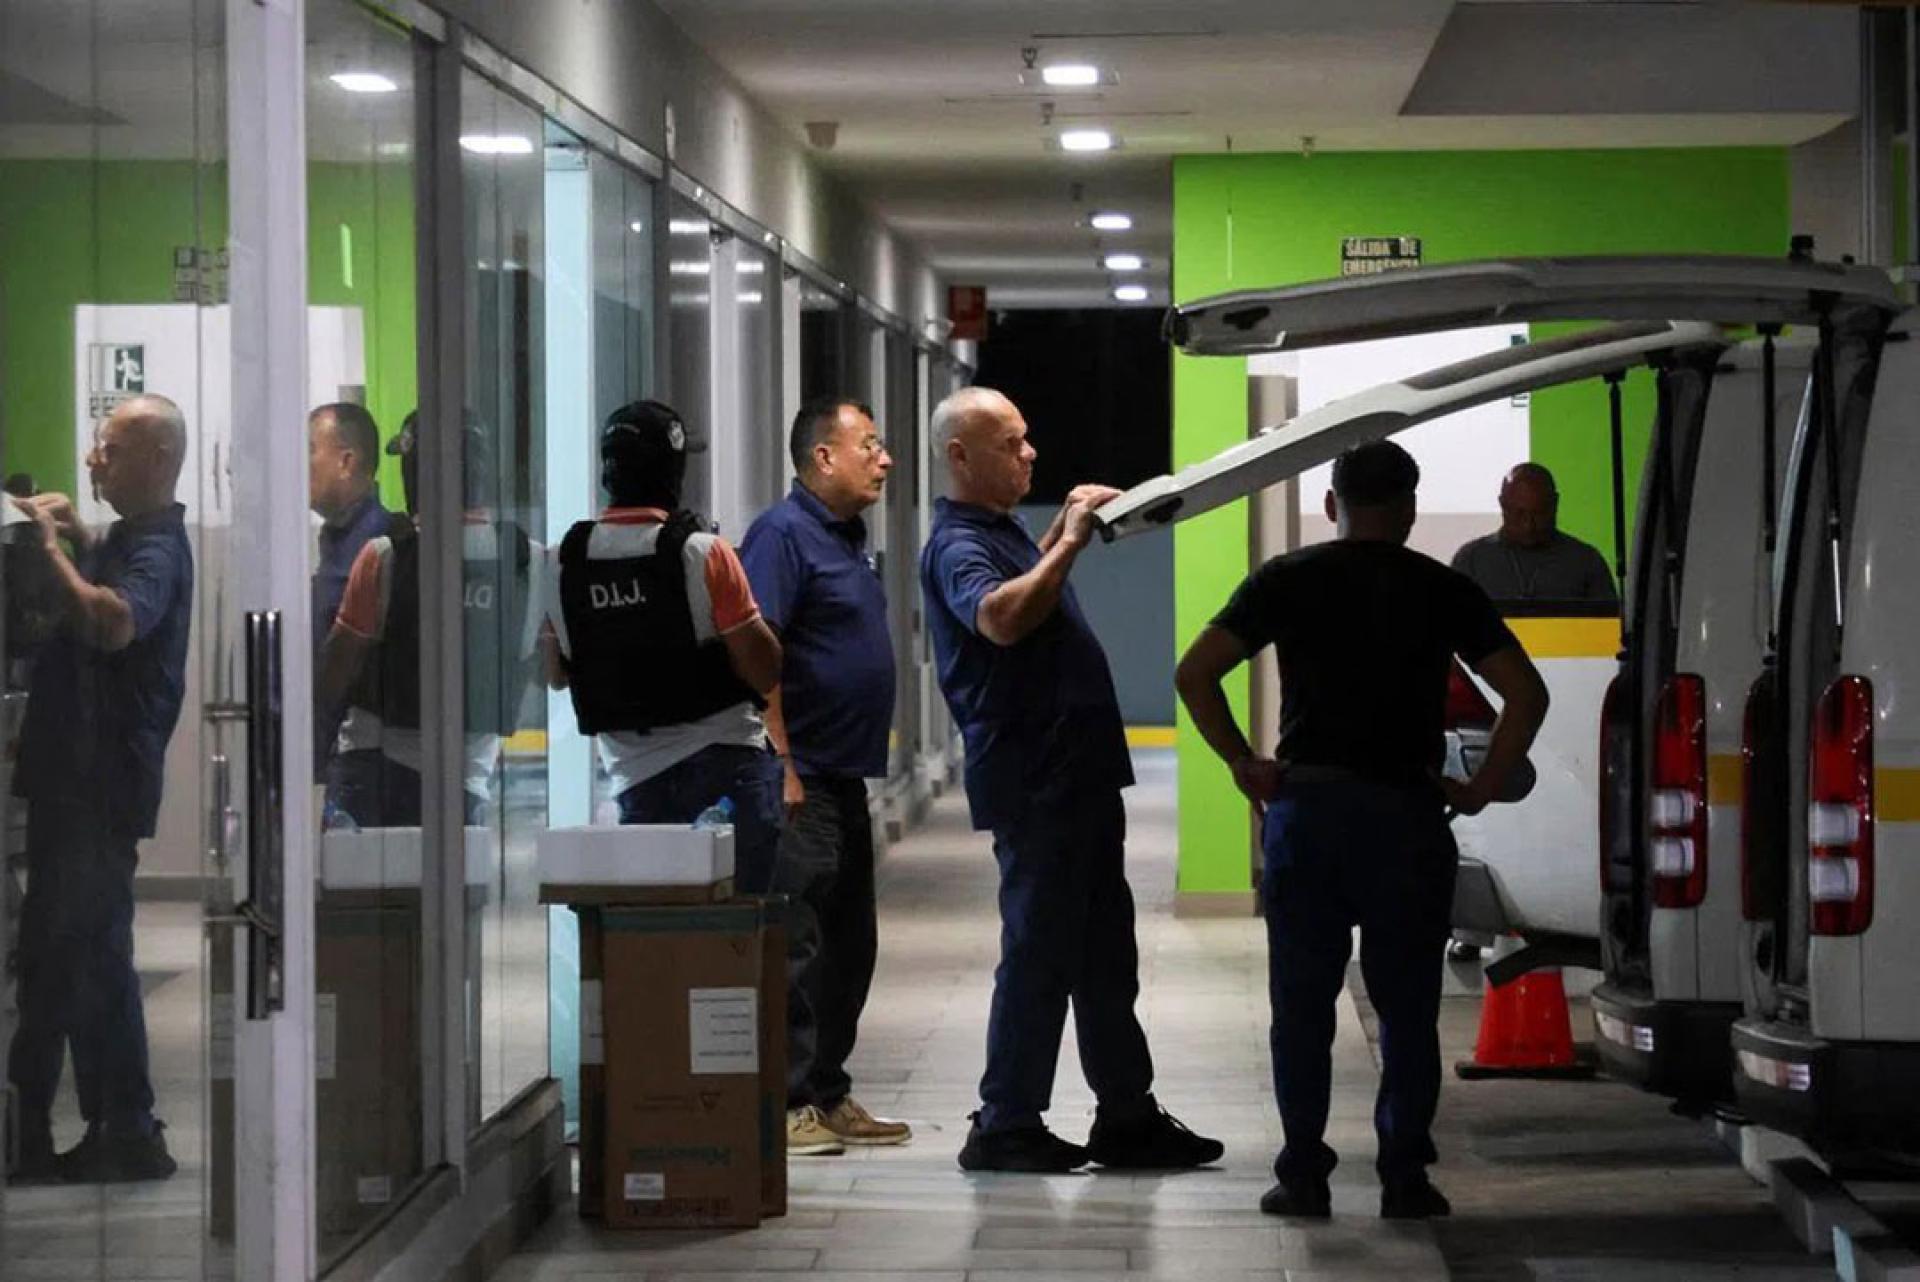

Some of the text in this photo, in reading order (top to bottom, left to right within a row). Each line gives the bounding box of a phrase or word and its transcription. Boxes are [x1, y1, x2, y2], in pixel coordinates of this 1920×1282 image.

[1346, 239, 1417, 256] SALIDA DE
[591, 577, 646, 608] D.I.J.
